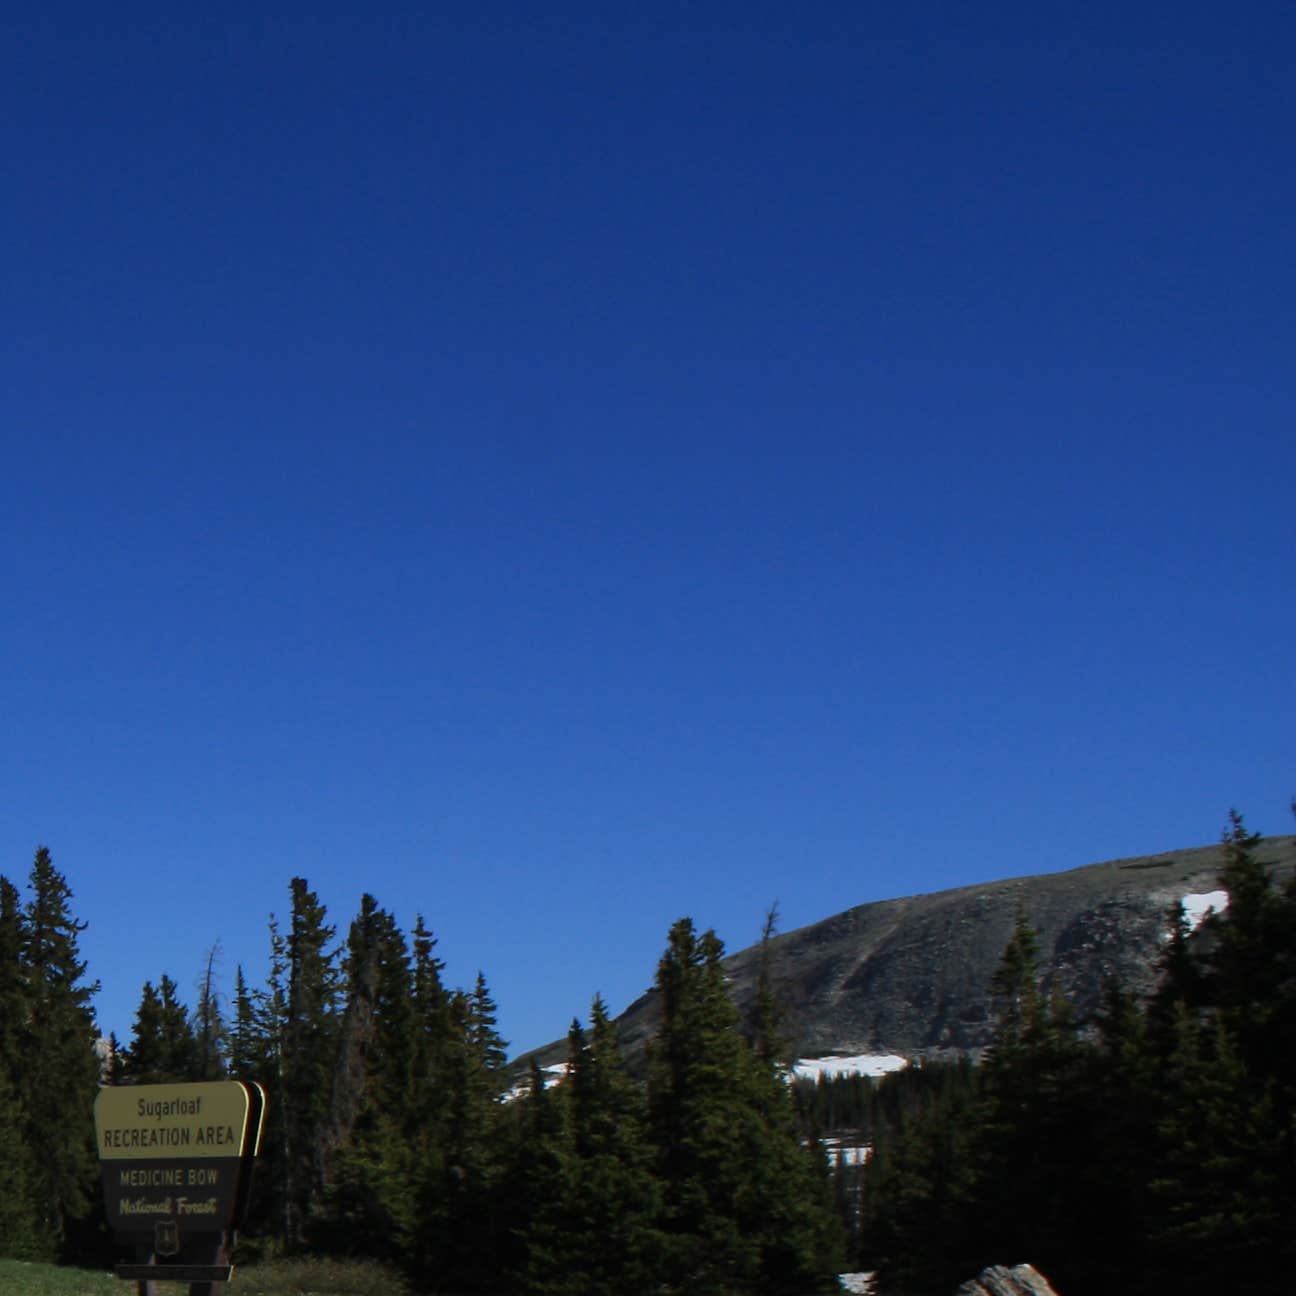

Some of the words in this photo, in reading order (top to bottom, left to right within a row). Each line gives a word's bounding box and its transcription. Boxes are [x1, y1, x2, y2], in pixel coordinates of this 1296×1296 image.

[137, 1096, 202, 1120] Sugarloaf
[104, 1127, 189, 1147] RECREATION
[196, 1126, 235, 1145] AREA
[119, 1168, 185, 1187] MEDICINE
[188, 1167, 219, 1186] BOW
[119, 1196, 172, 1215] National
[176, 1195, 218, 1215] Forest
